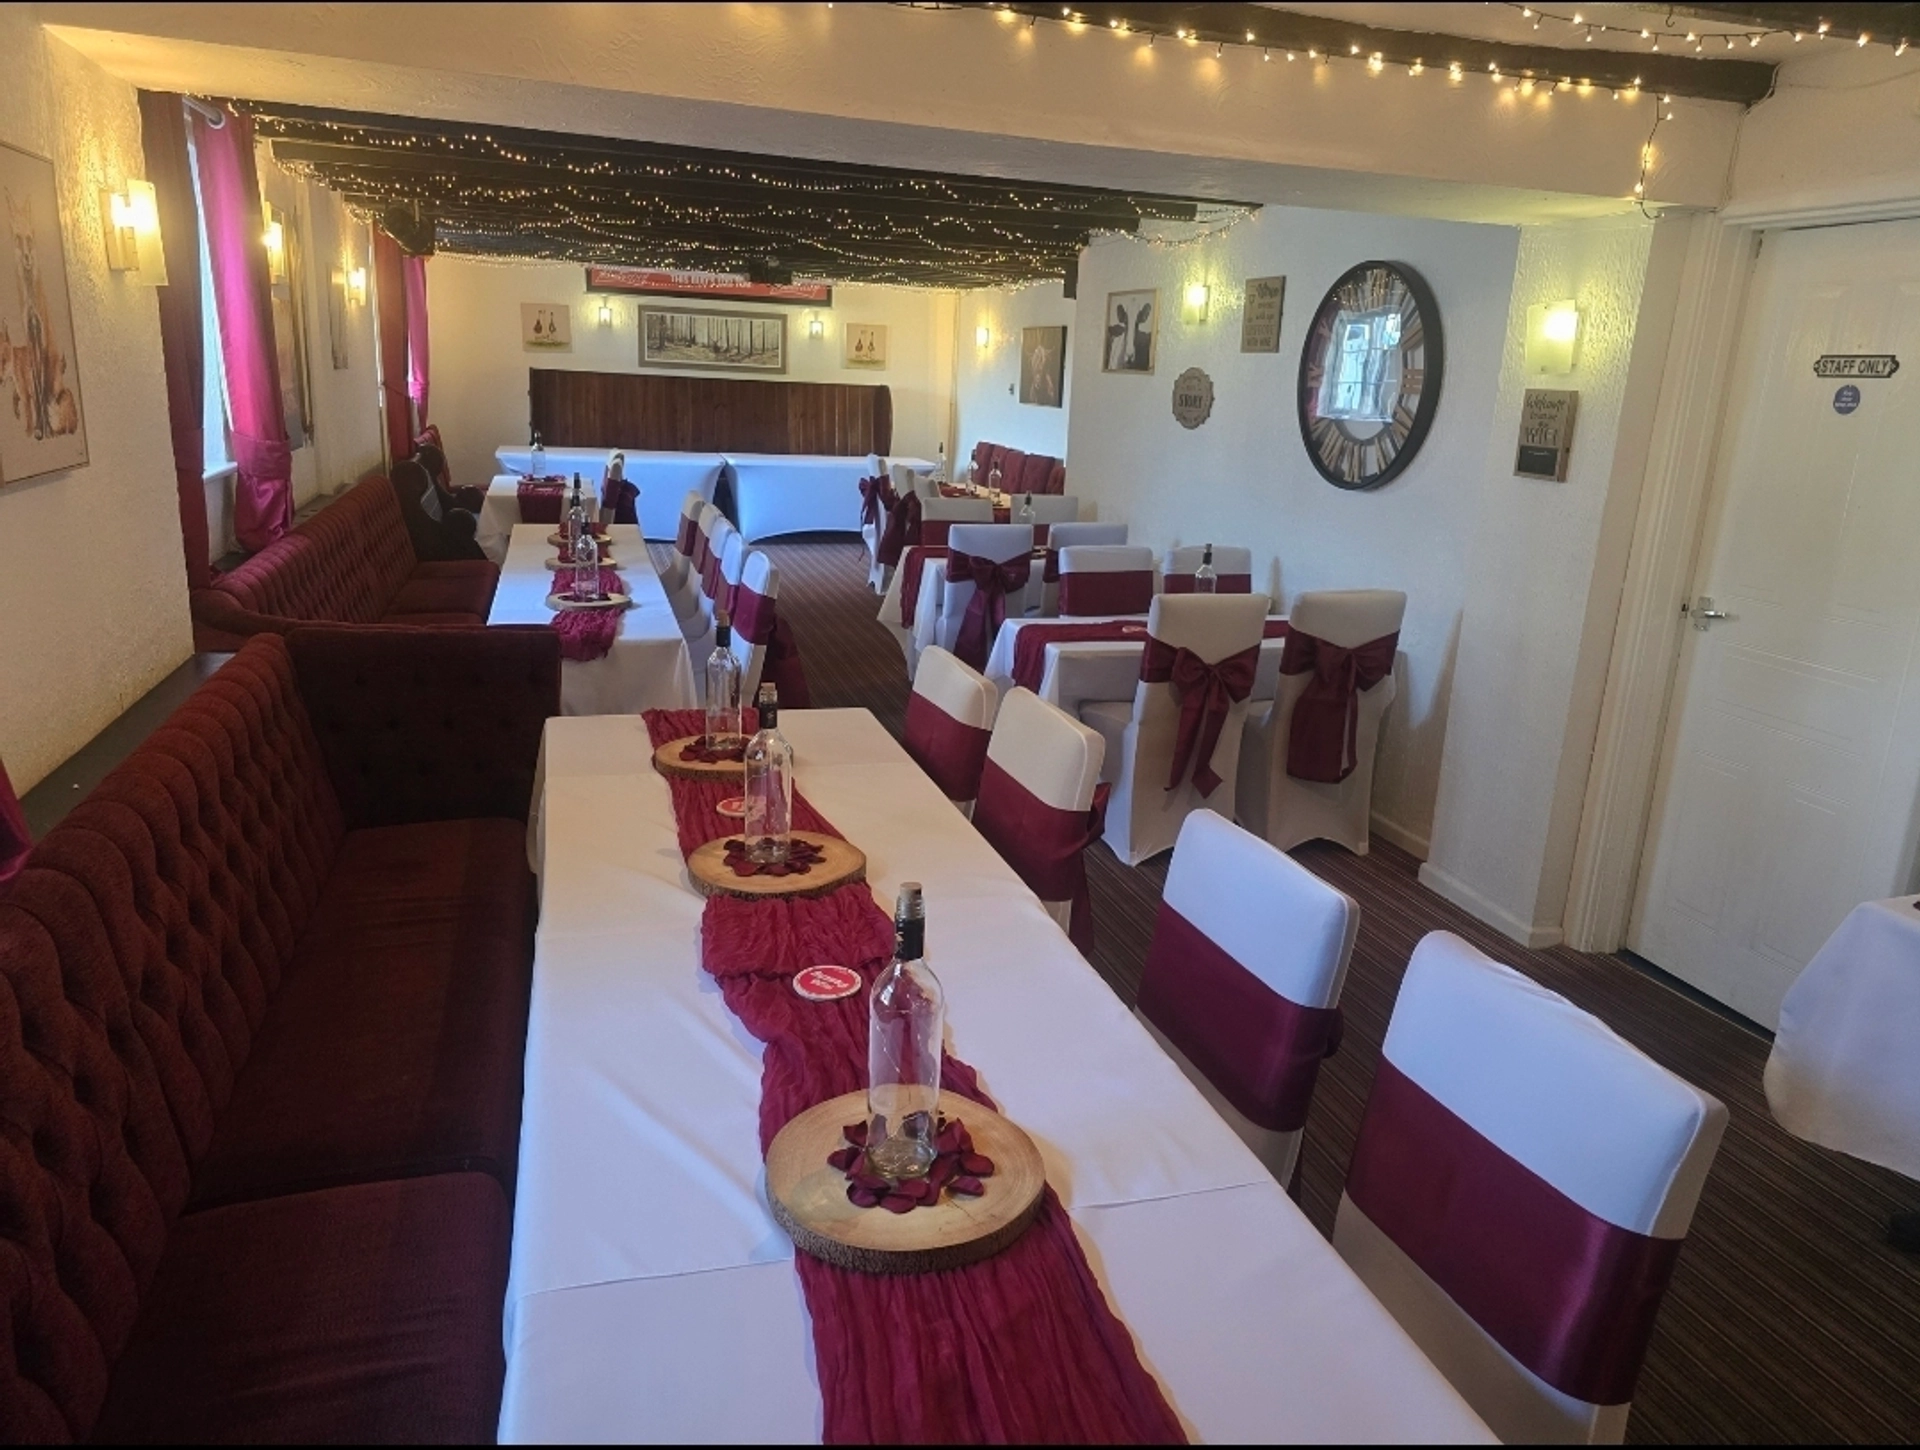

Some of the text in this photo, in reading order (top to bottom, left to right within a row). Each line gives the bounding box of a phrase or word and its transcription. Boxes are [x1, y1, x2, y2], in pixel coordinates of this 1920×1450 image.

[1821, 360, 1889, 374] STAFF ONLY
[1178, 394, 1204, 408] STORY
